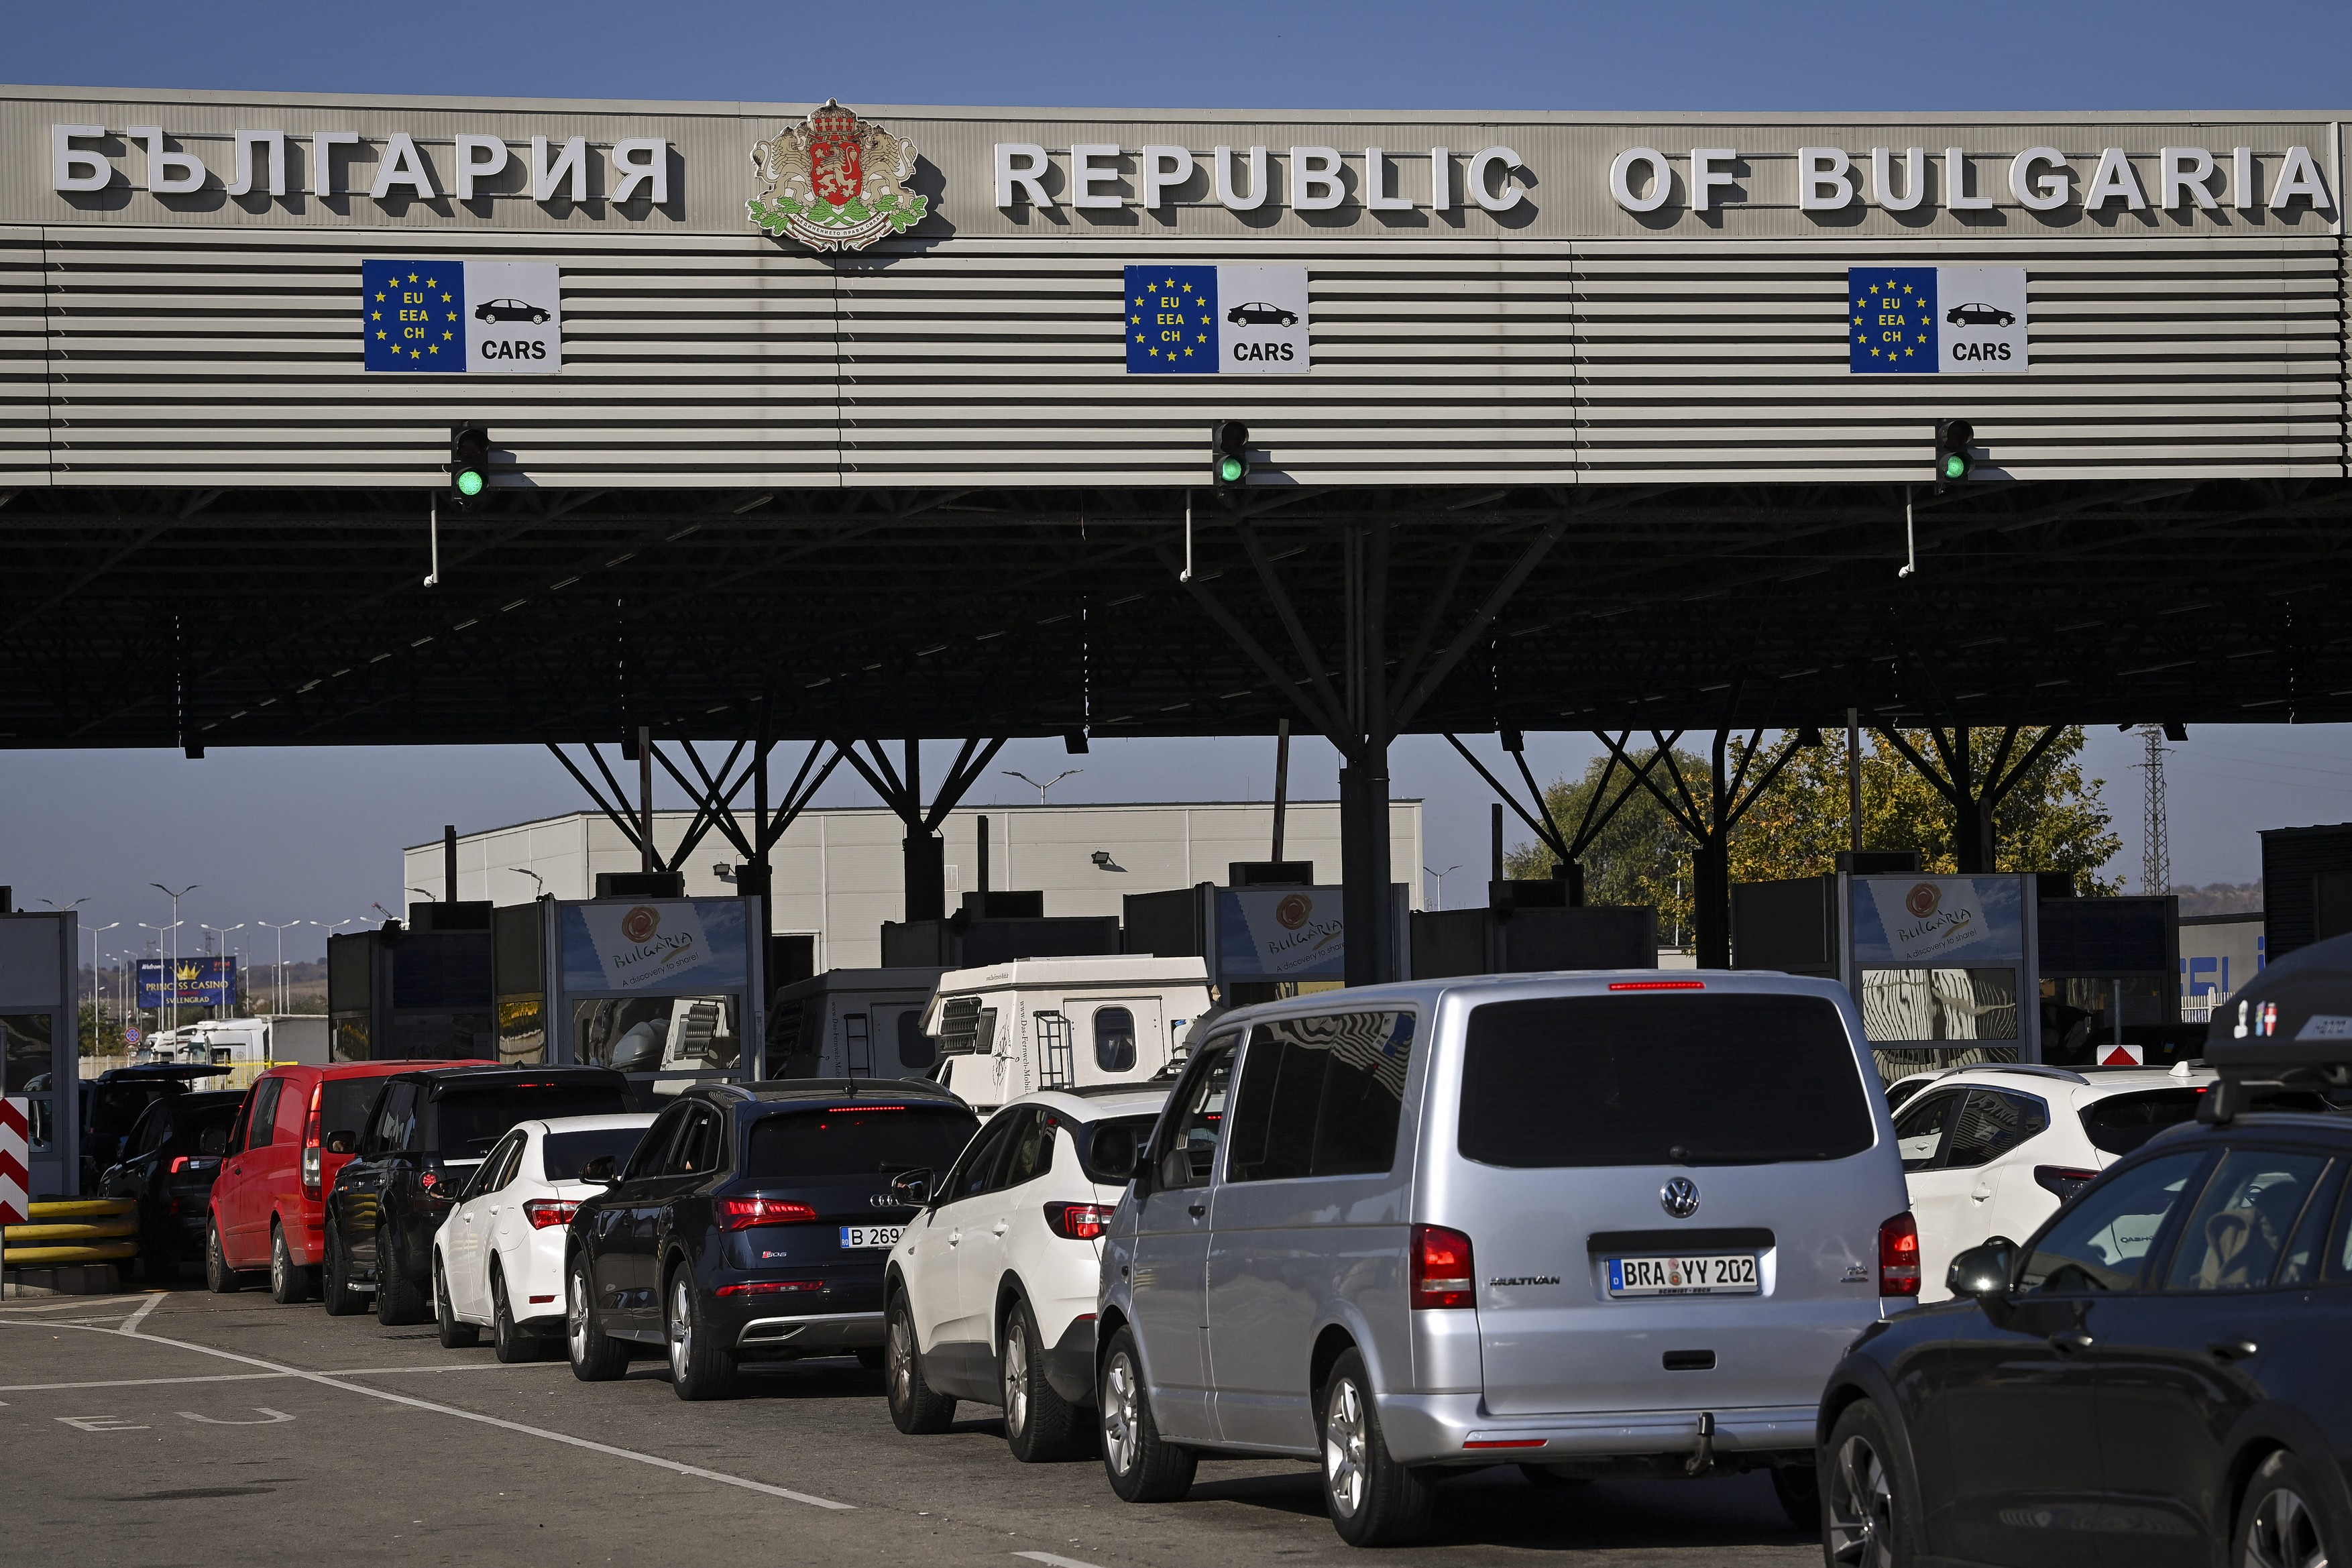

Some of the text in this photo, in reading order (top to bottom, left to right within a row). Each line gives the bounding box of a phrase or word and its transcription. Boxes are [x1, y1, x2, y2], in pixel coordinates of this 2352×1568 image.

[52, 123, 667, 204] БЪЛГАРИЯ
[994, 142, 2331, 213] REPUBLIC OF BULGARIA
[793, 212, 885, 236] СЪЕДИНЕНИЕТО ПРАВИ СИЛАТА
[404, 292, 423, 304] EU
[1161, 297, 1179, 308] EU
[1883, 298, 1900, 309] EU
[400, 310, 429, 321] EEA
[1157, 314, 1184, 325] EEA
[1879, 315, 1905, 325] EEA
[404, 327, 425, 339] CH
[1161, 331, 1180, 341] CH
[1883, 331, 1901, 341] CH
[481, 340, 546, 359] CARS
[1233, 343, 1294, 361] CARS
[1952, 343, 2011, 361] CARS
[1913, 941, 1946, 958] discovery
[1284, 954, 1317, 969] discovery
[630, 966, 665, 985] discovery
[146, 981, 229, 991] PRINCSS CASINO
[1019, 1000, 1031, 1095] www.Das-Fernweh-Mobil.
[851, 1229, 863, 1245] B
[870, 1228, 899, 1245] 269
[1613, 1259, 1754, 1286] D BRA YY 202
[1490, 1276, 1561, 1286] MULTIVAN
[53, 1408, 296, 1431] EU
